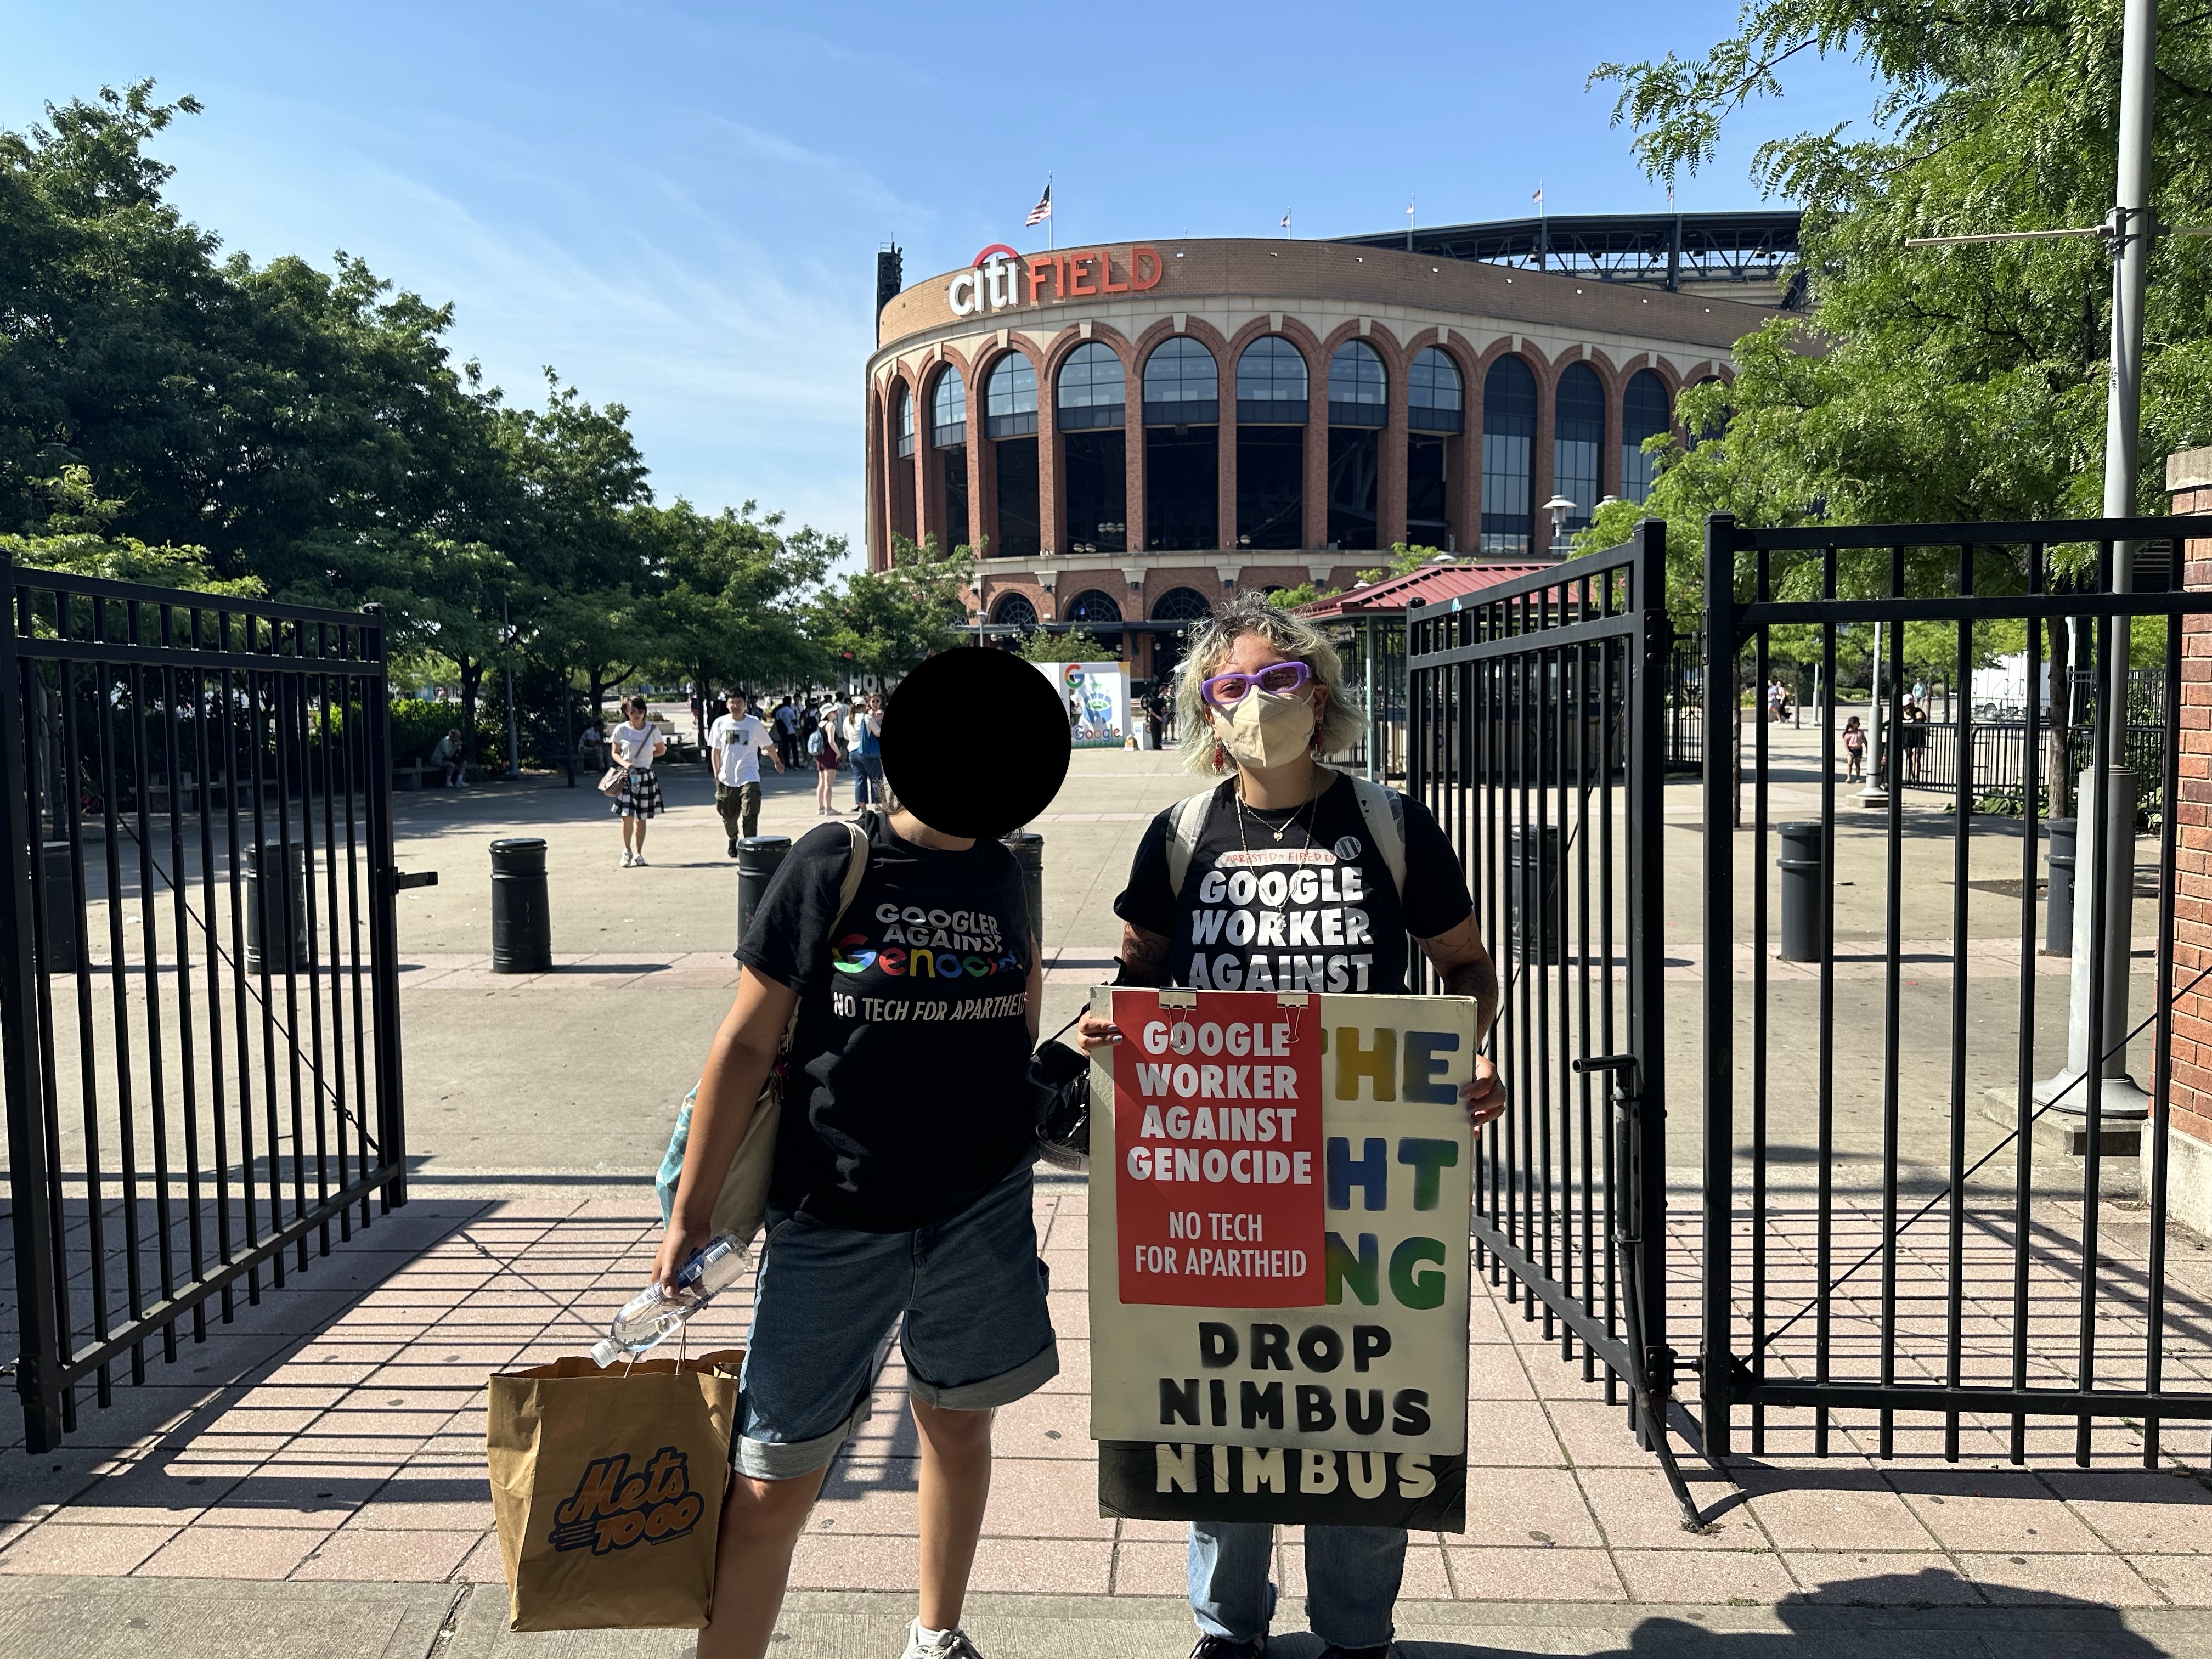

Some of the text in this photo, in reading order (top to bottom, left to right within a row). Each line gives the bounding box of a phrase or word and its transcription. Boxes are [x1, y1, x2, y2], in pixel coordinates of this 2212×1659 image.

[949, 249, 1162, 316] citi FIELD
[1073, 724, 1120, 742] Google
[1199, 867, 1364, 906] GOOGLE
[876, 903, 1000, 935] GOOGLER
[882, 924, 1002, 953] AGAINST
[1192, 907, 1374, 947] WORKER
[1189, 952, 1373, 992] AGAINST
[833, 991, 856, 1018] NO
[862, 997, 907, 1022] TECH
[912, 1002, 948, 1021] FOR
[1143, 1020, 1290, 1057] GOOGLE
[1136, 1063, 1299, 1099] WORKER
[1321, 1026, 1460, 1105] HE
[1140, 1105, 1297, 1142] AGAINST
[1127, 1146, 1312, 1185] GENOCIDE
[1327, 1137, 1459, 1211] HT
[1169, 1211, 1262, 1242] NO TECH
[1136, 1245, 1306, 1278] FOR APARTHEID
[1325, 1232, 1446, 1310] NG
[1198, 1321, 1392, 1373] DROP
[1159, 1378, 1431, 1436] NIMBUS
[558, 1452, 685, 1524] Mets
[1155, 1443, 1436, 1499] NIMBUS
